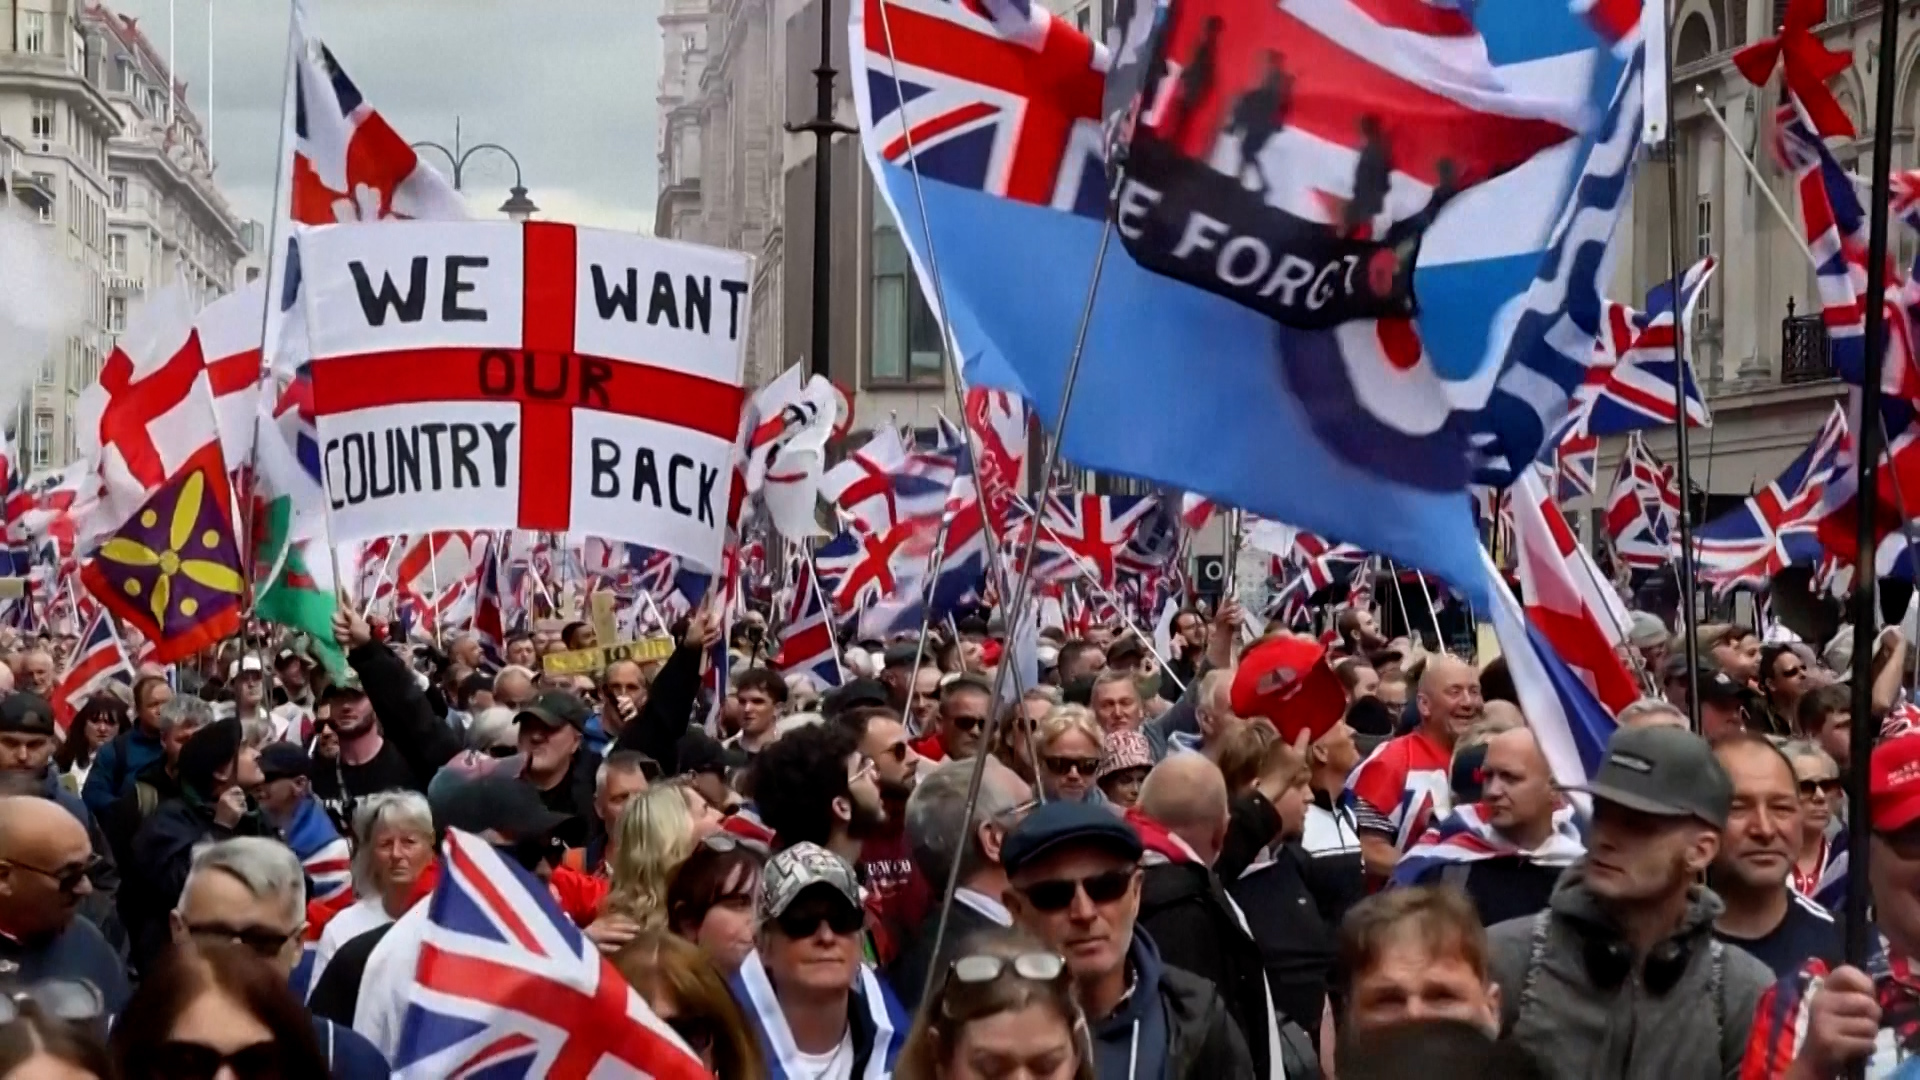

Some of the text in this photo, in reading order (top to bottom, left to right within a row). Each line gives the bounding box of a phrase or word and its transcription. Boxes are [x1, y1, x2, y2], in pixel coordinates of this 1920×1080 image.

[348, 255, 748, 339] WE WANT
[477, 349, 613, 407] OUR
[325, 422, 720, 528] COUNTRY BACK
